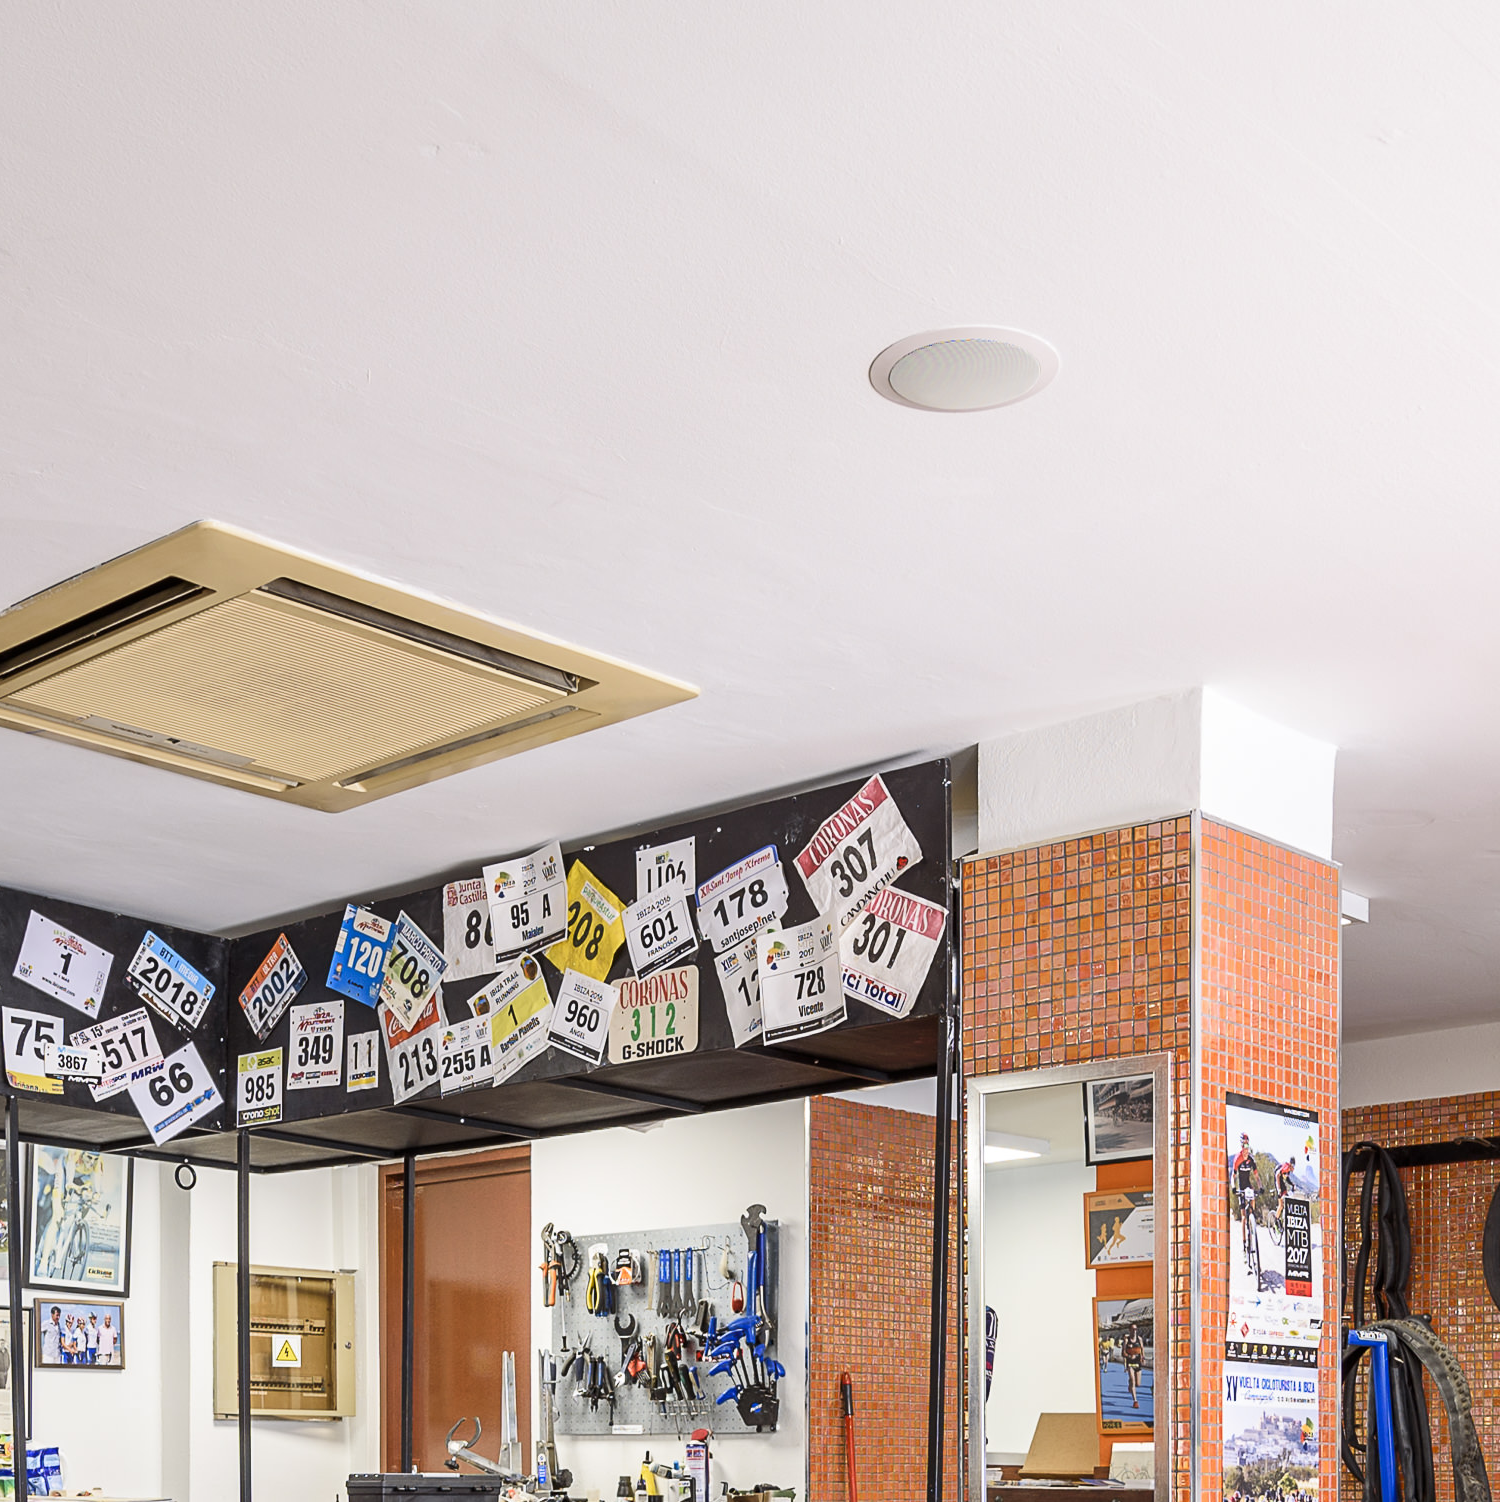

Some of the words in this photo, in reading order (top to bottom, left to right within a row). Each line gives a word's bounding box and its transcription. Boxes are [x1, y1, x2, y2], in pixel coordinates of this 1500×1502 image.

[809, 790, 876, 867] CORONAS
[831, 826, 878, 898] 307
[458, 881, 481, 894] Junta
[459, 890, 488, 905] Castilla
[713, 879, 768, 927] 178
[511, 901, 529, 929] 95
[542, 893, 551, 919] A
[636, 906, 655, 920] IBIZA
[869, 889, 933, 934] ORONAS
[640, 910, 679, 949] 601
[853, 913, 907, 969] 301
[159, 947, 174, 962] BTT
[347, 937, 383, 978] 120
[401, 923, 421, 951] MARCO
[420, 944, 442, 970] PRIETO
[647, 935, 678, 958] FRANCISCO
[798, 947, 815, 959] 2017
[60, 952, 72, 976] 1
[389, 939, 430, 998] 708
[139, 956, 198, 1016] 2018
[252, 956, 296, 1023] 2002
[489, 982, 504, 998] IBIZA
[573, 983, 591, 998] IBIZA
[619, 970, 689, 1009] CORONAS
[794, 966, 825, 1000] 728
[865, 978, 902, 1009] Total
[508, 1004, 518, 1026] 1
[565, 999, 600, 1032] 960
[630, 1002, 676, 1042] 312
[798, 1001, 824, 1017] Vicente
[11, 1016, 55, 1060] 75
[298, 1034, 334, 1066] 349
[622, 1036, 684, 1060] G-SHOCK
[58, 1054, 88, 1072] 3867
[131, 1060, 164, 1082] MRW
[400, 1038, 438, 1091] 213
[442, 1049, 475, 1079] 255
[480, 1044, 492, 1068] A
[149, 1062, 193, 1107] 66
[245, 1073, 275, 1104] 985
[1287, 1203, 1308, 1216] VUELTA
[1287, 1216, 1308, 1230] IBIZA
[1287, 1230, 1309, 1248] MTB
[1287, 1247, 1308, 1264] 2017
[1226, 1375, 1238, 1401] XV
